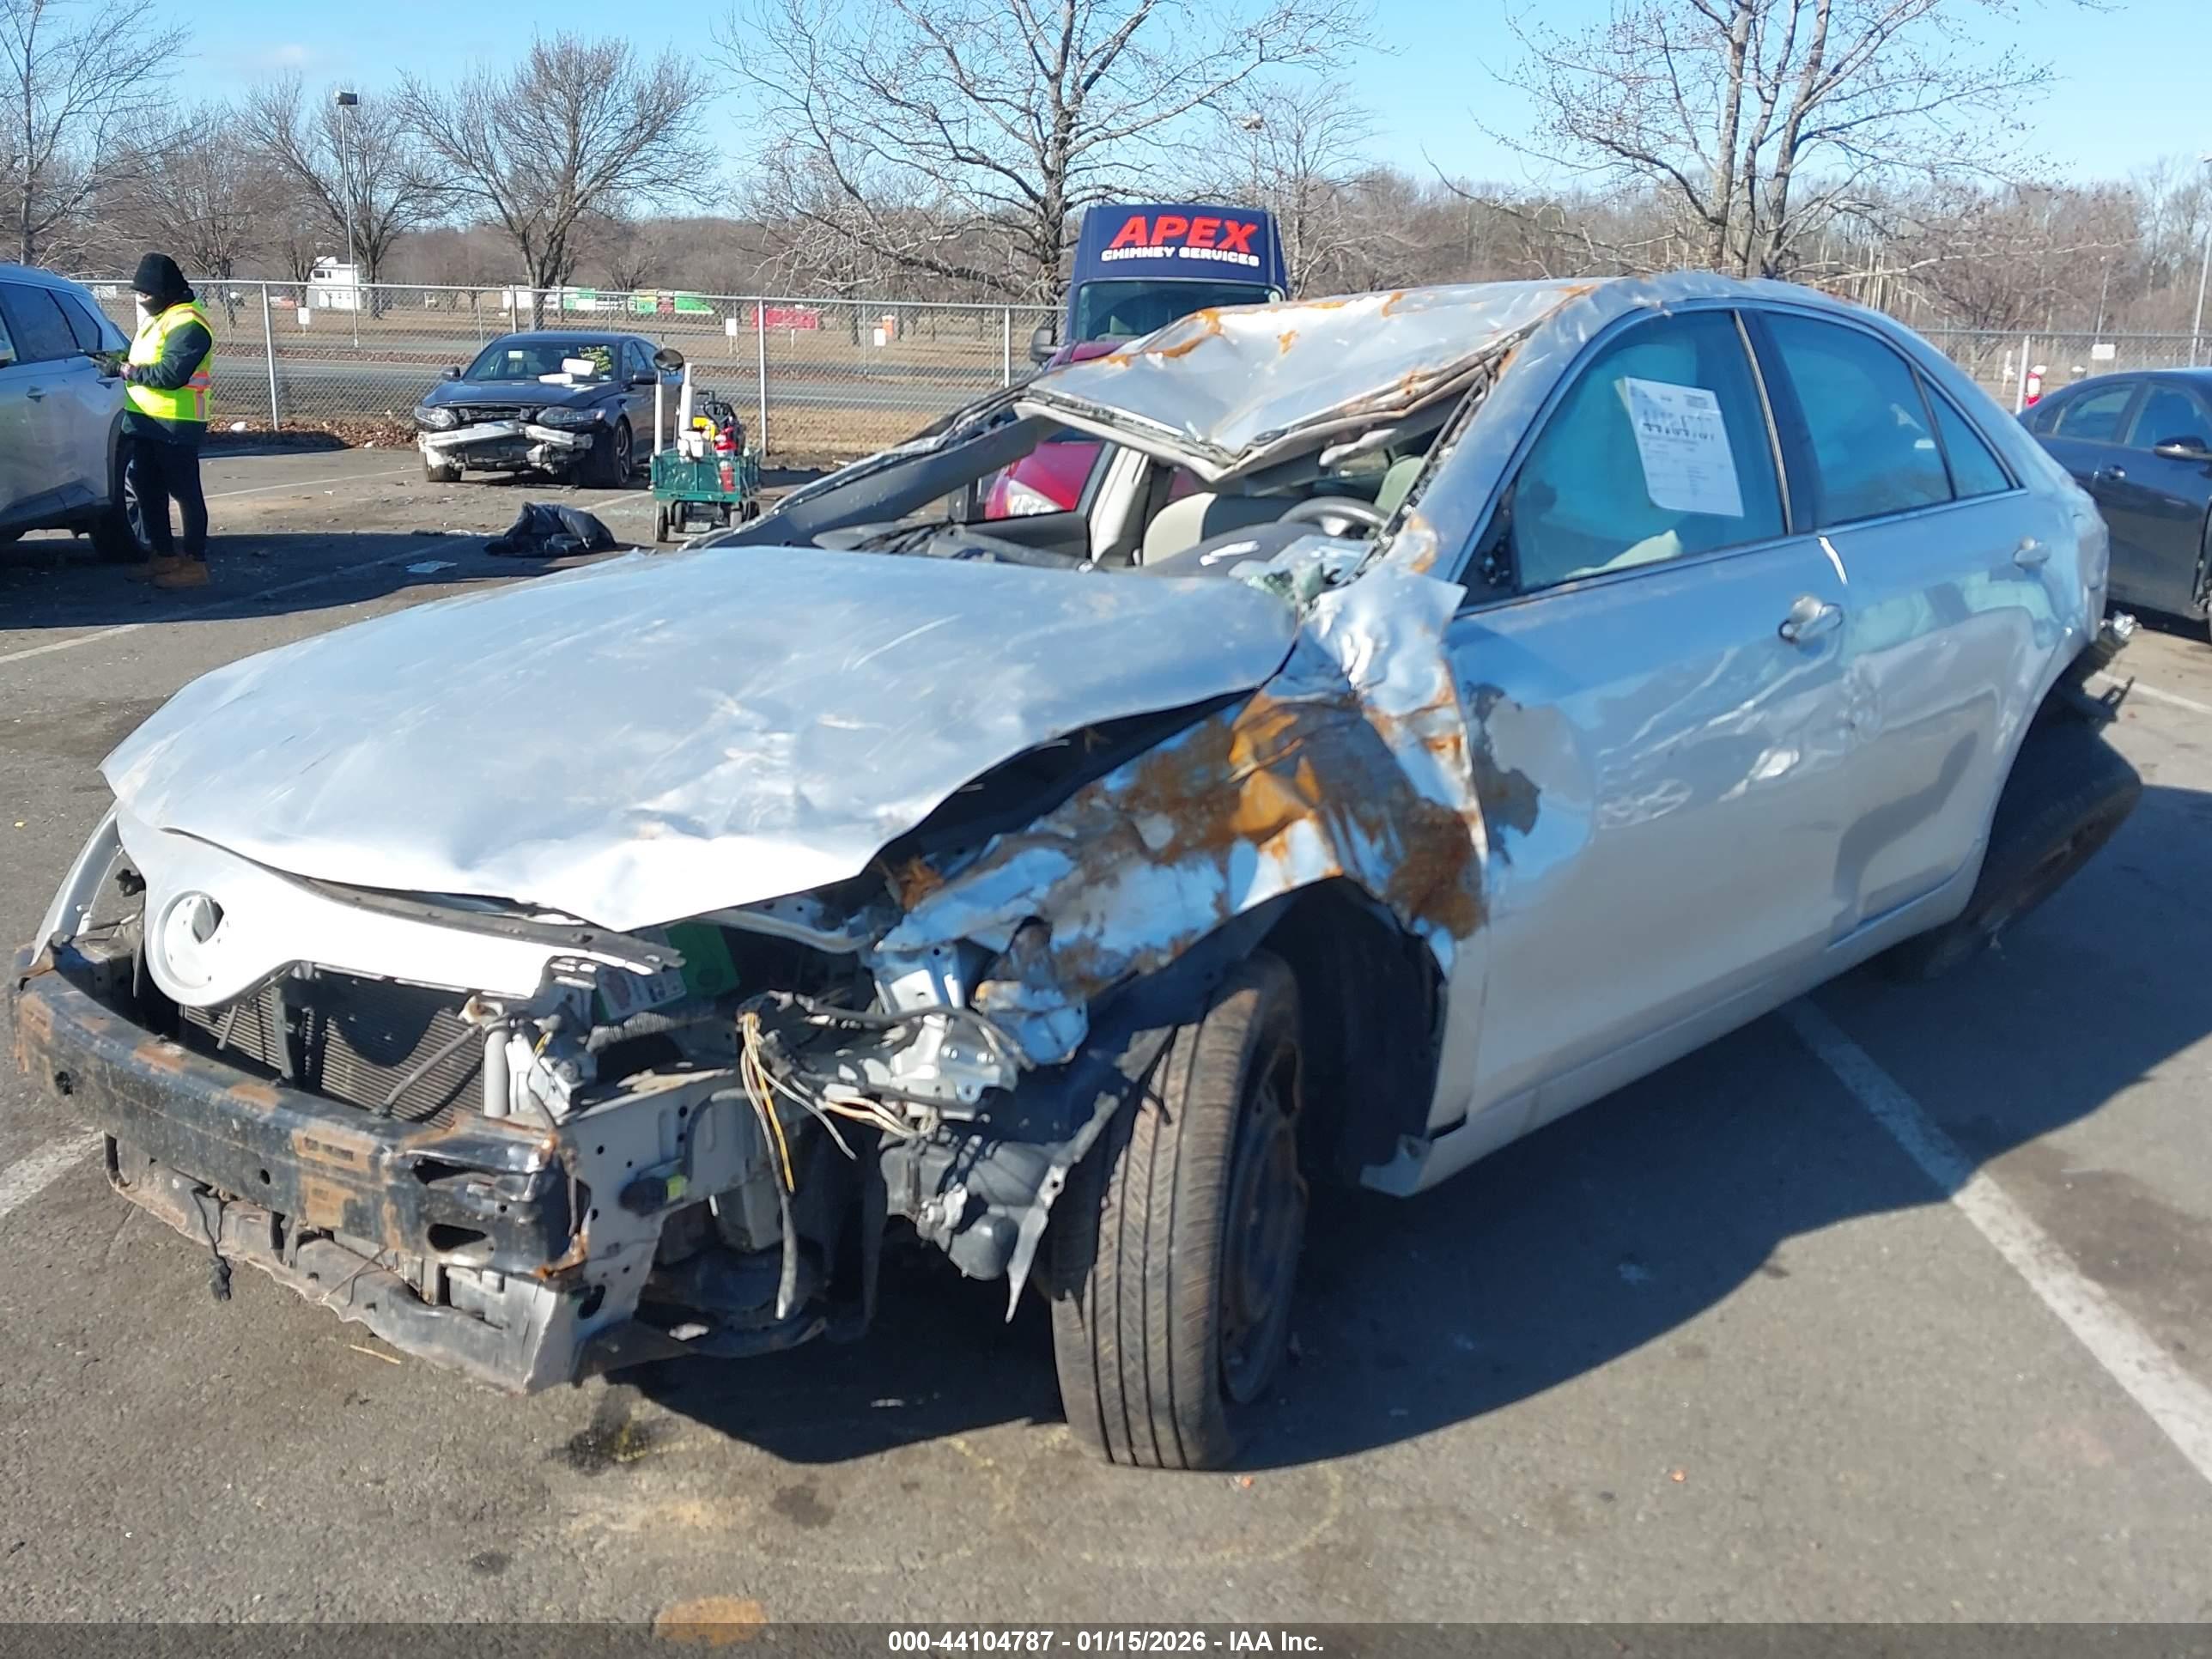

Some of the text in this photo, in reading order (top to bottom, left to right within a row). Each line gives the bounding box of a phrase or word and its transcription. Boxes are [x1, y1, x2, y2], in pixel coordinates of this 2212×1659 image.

[1109, 216, 1258, 252] APEX
[1101, 246, 1260, 266] CHIMNEY SERVICES
